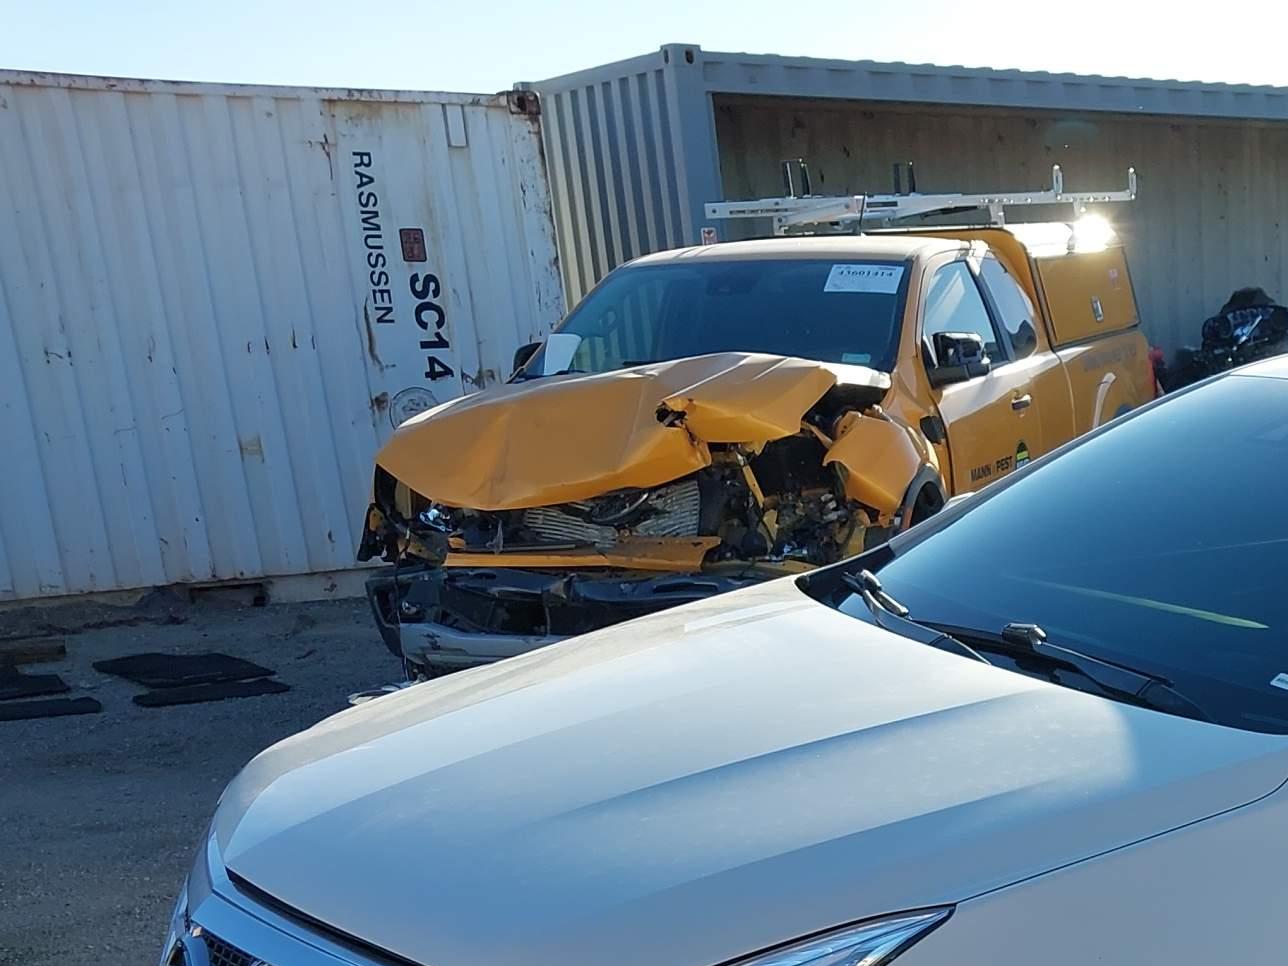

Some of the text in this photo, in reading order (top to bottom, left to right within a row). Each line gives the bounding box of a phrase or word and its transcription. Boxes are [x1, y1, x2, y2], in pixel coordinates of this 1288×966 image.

[352, 150, 395, 324] RASMUSSEN
[409, 272, 454, 381] SC14
[996, 455, 1012, 473] PEST
